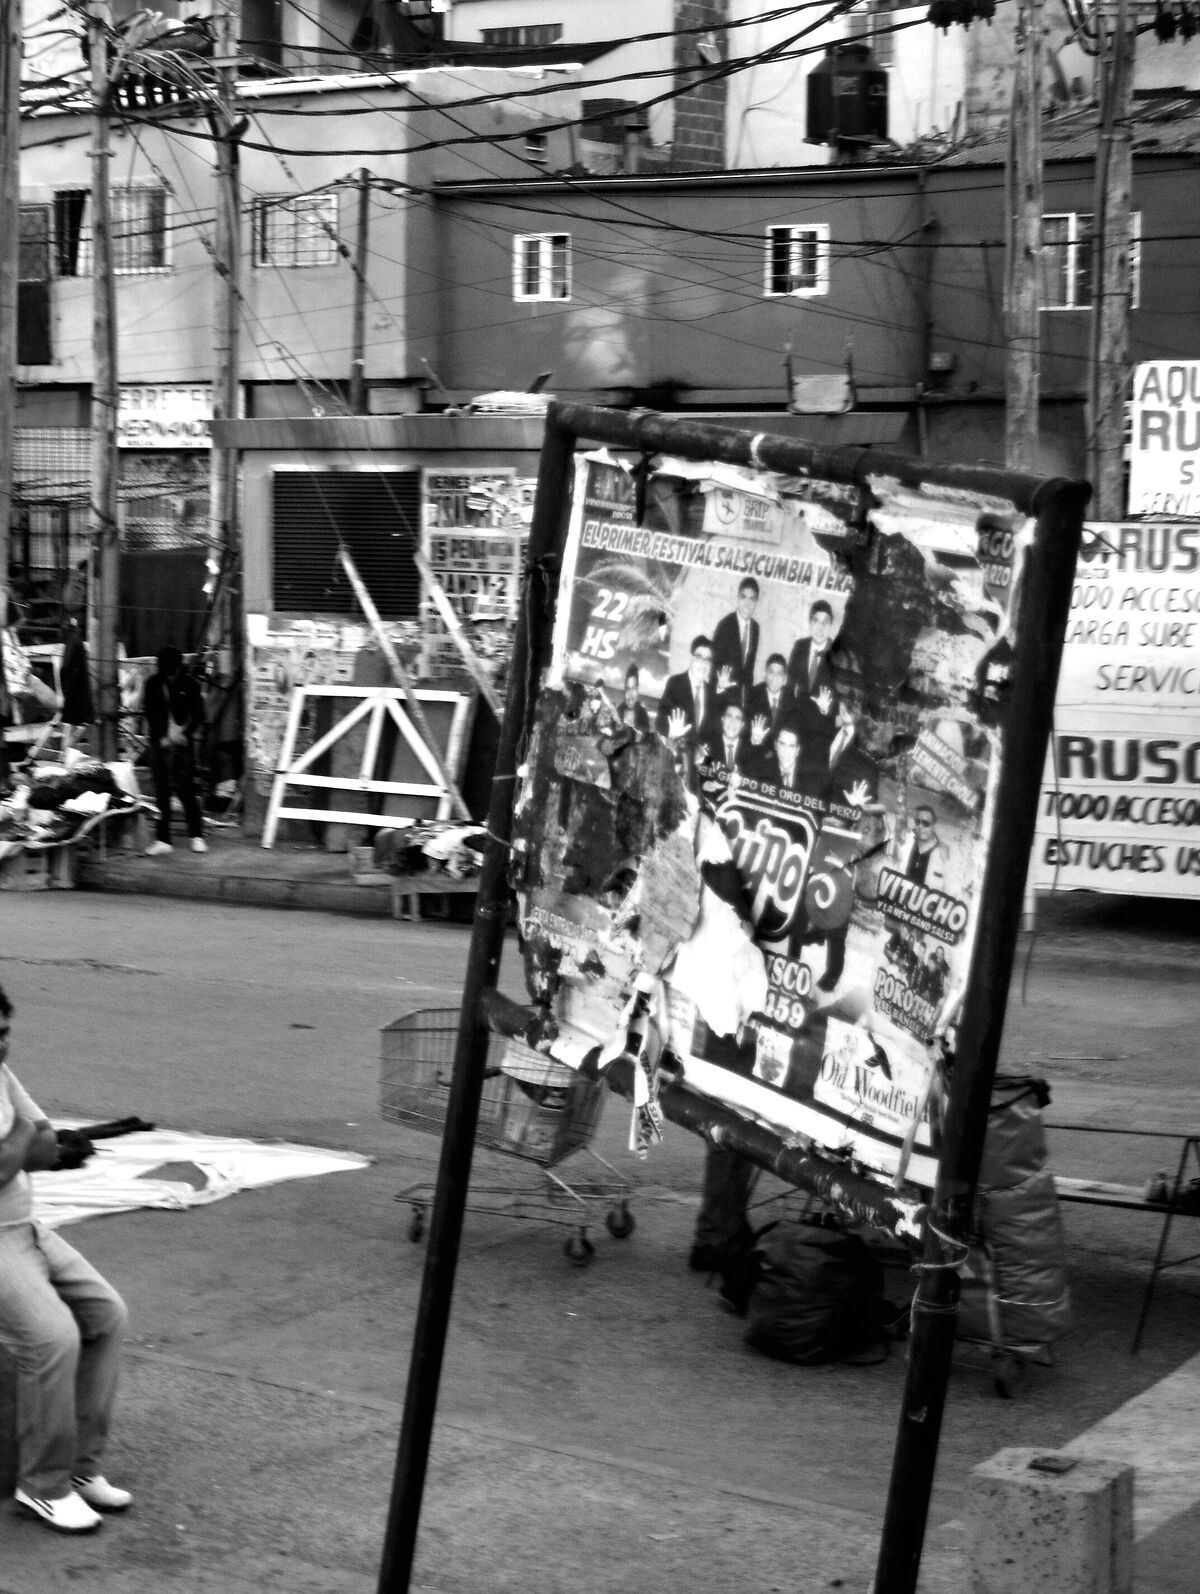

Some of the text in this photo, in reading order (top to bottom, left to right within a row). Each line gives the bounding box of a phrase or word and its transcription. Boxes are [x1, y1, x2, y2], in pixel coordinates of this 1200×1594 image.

[582, 521, 600, 548] EL
[600, 523, 652, 558] PRIMER
[651, 532, 713, 567] FESTIVAL
[714, 545, 814, 587] SALSICUMBIA
[591, 588, 629, 622] 22
[1071, 585, 1114, 610] ODO
[580, 626, 620, 659] HS
[1096, 663, 1200, 695] SERVIC
[761, 783, 776, 797] DE
[779, 789, 802, 804] ORO
[804, 795, 826, 811] DEL
[829, 803, 862, 820] PERU
[1044, 791, 1109, 821] TODO
[1044, 838, 1168, 873] ESTUCHES
[878, 869, 967, 932] VITUCHO
[910, 913, 931, 931] BAND
[930, 925, 956, 943] SALSA
[821, 1053, 849, 1089] Old
